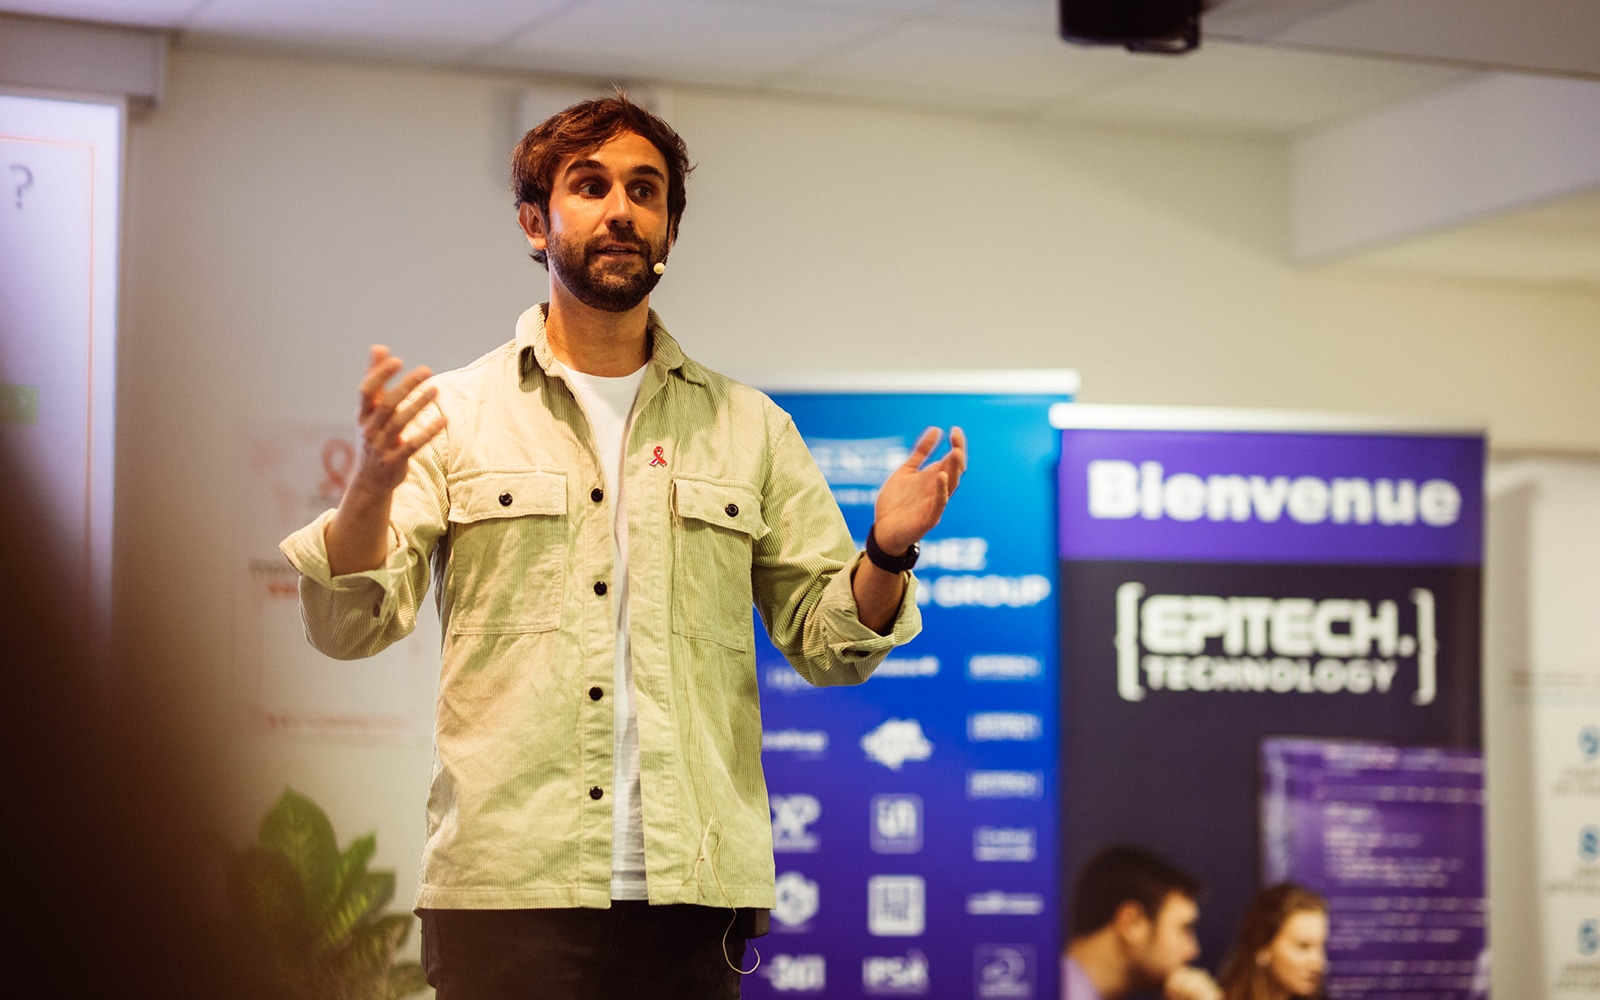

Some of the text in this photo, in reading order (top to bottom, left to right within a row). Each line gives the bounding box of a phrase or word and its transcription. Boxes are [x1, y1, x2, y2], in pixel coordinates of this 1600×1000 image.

[9, 164, 34, 209] ?
[1087, 459, 1461, 526] Bienvenue
[916, 537, 987, 571] HEZ
[934, 575, 1051, 607] GROUP
[1143, 656, 1397, 693] TECHNOLOGY
